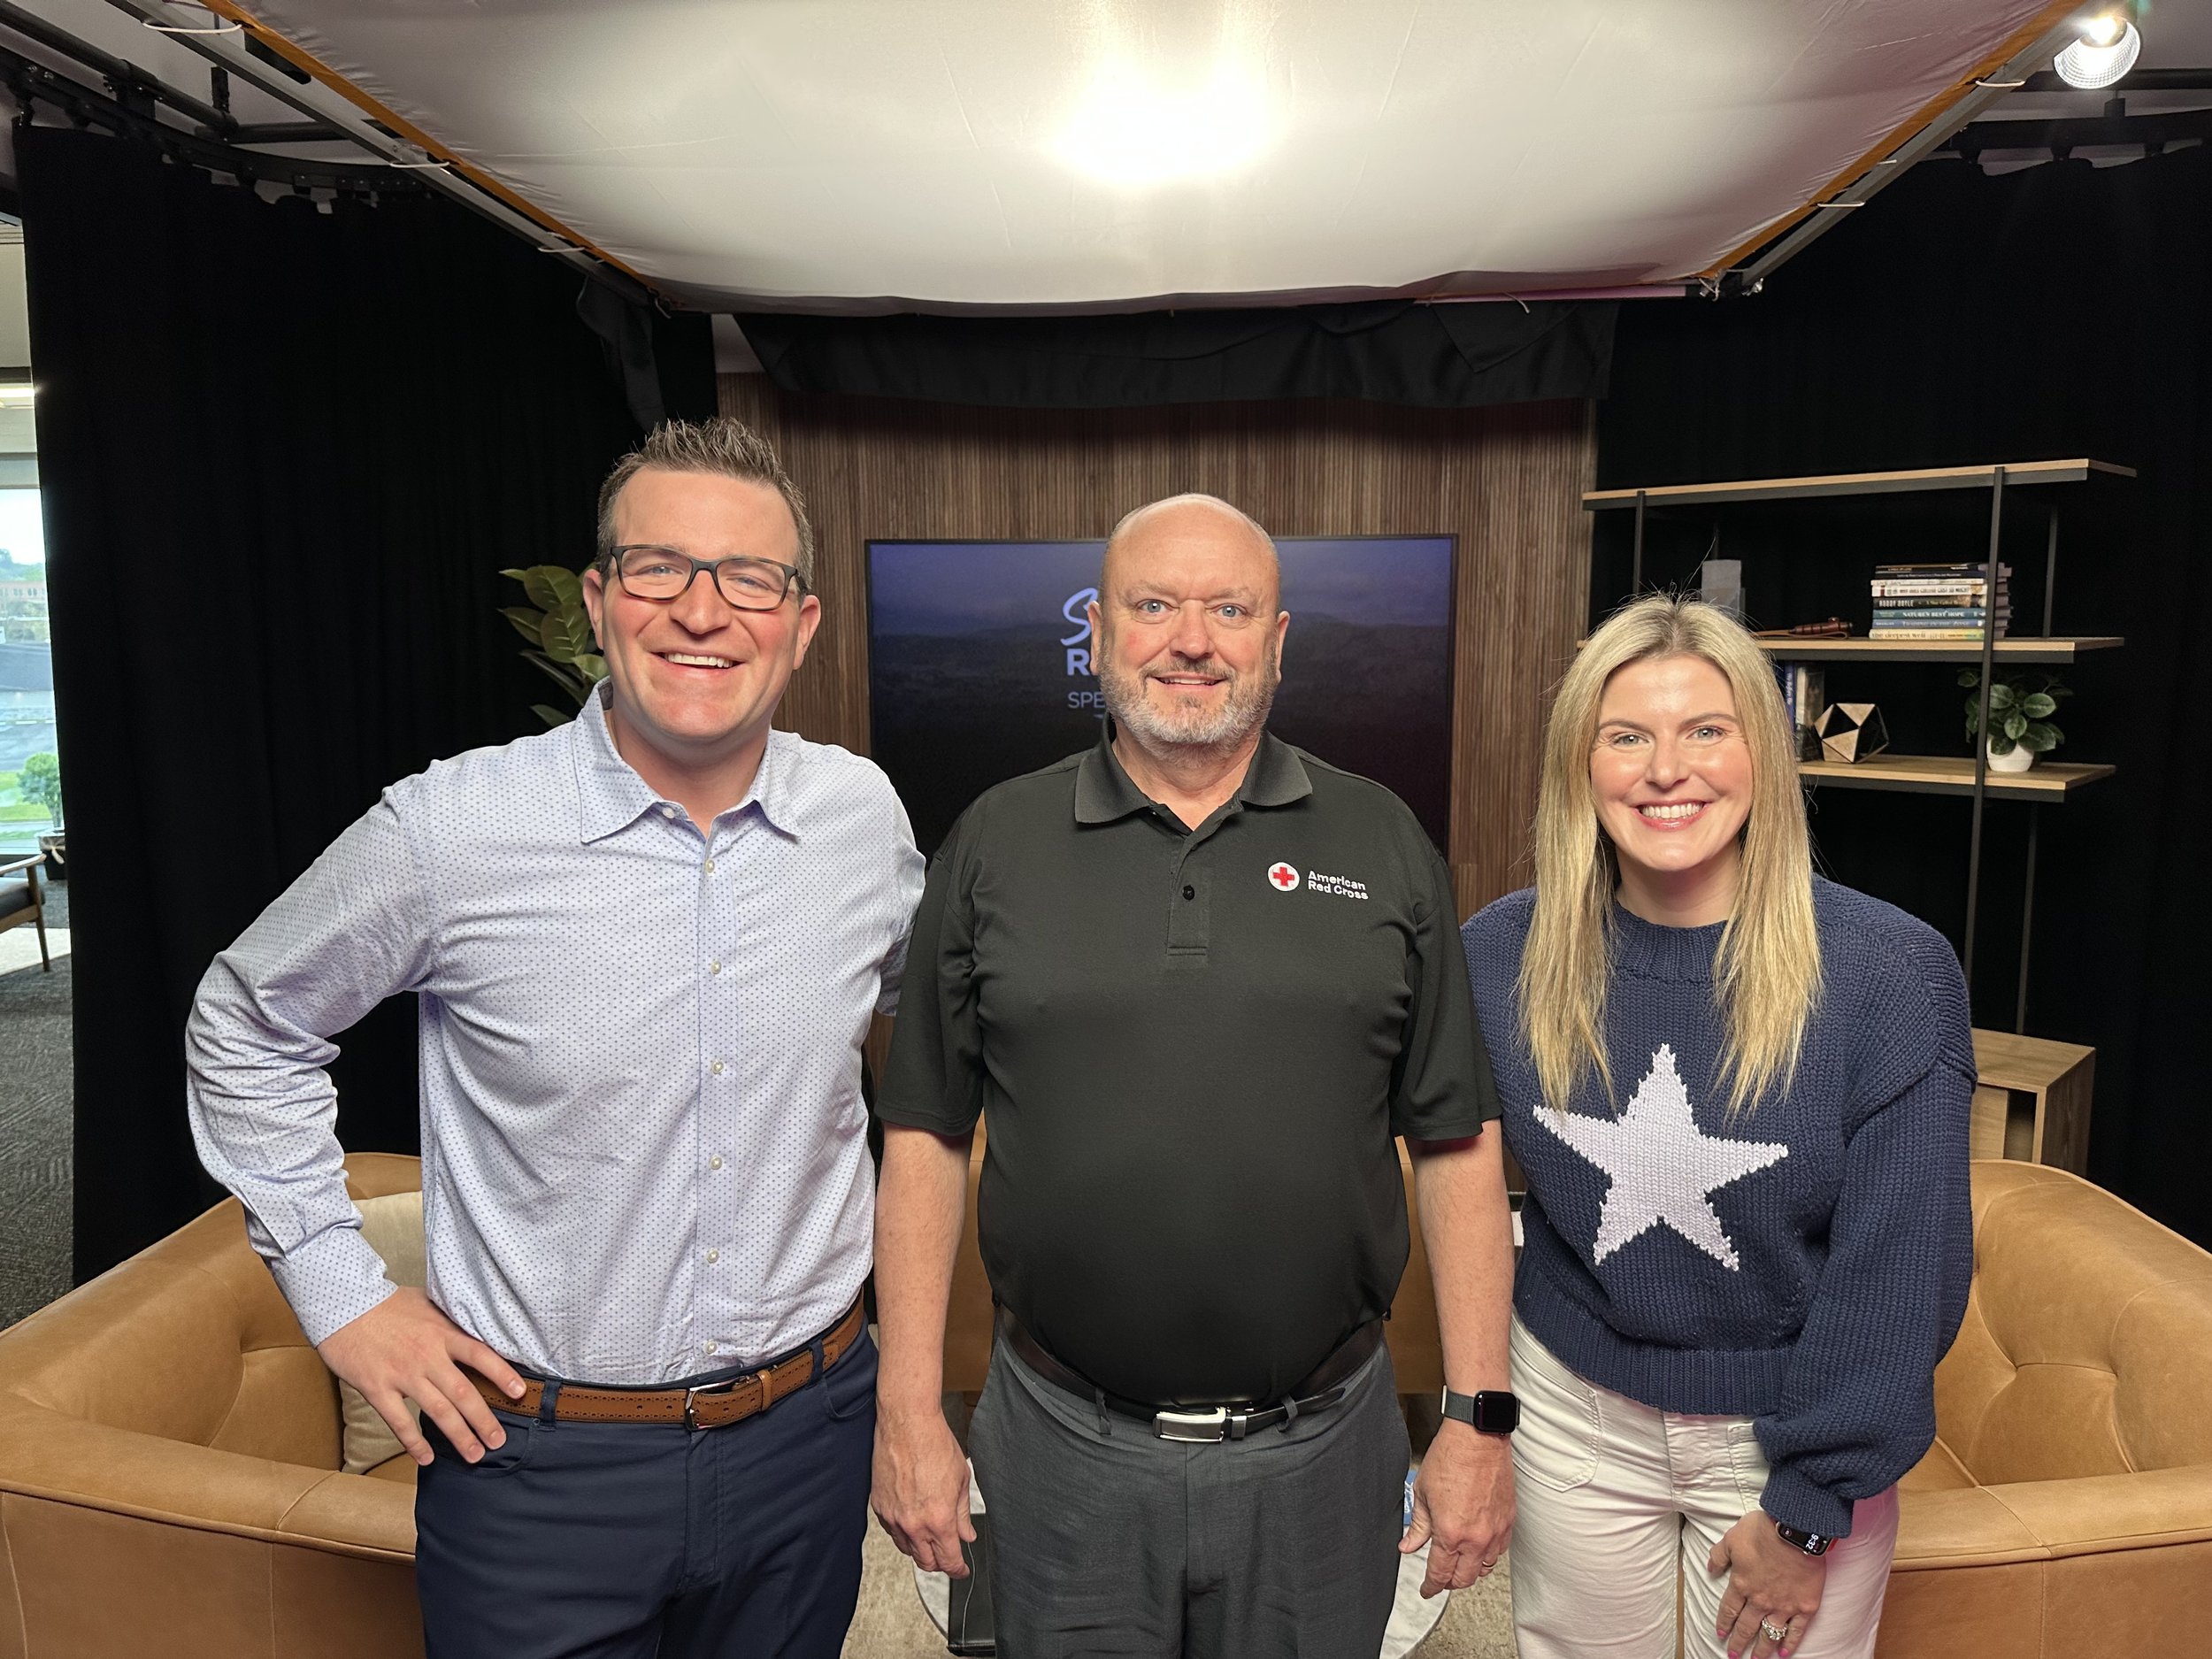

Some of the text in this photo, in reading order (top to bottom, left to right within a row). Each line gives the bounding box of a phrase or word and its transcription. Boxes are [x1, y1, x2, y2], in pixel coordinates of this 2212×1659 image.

[1308, 870, 1366, 890] American
[1308, 879, 1369, 900] Red Cross
